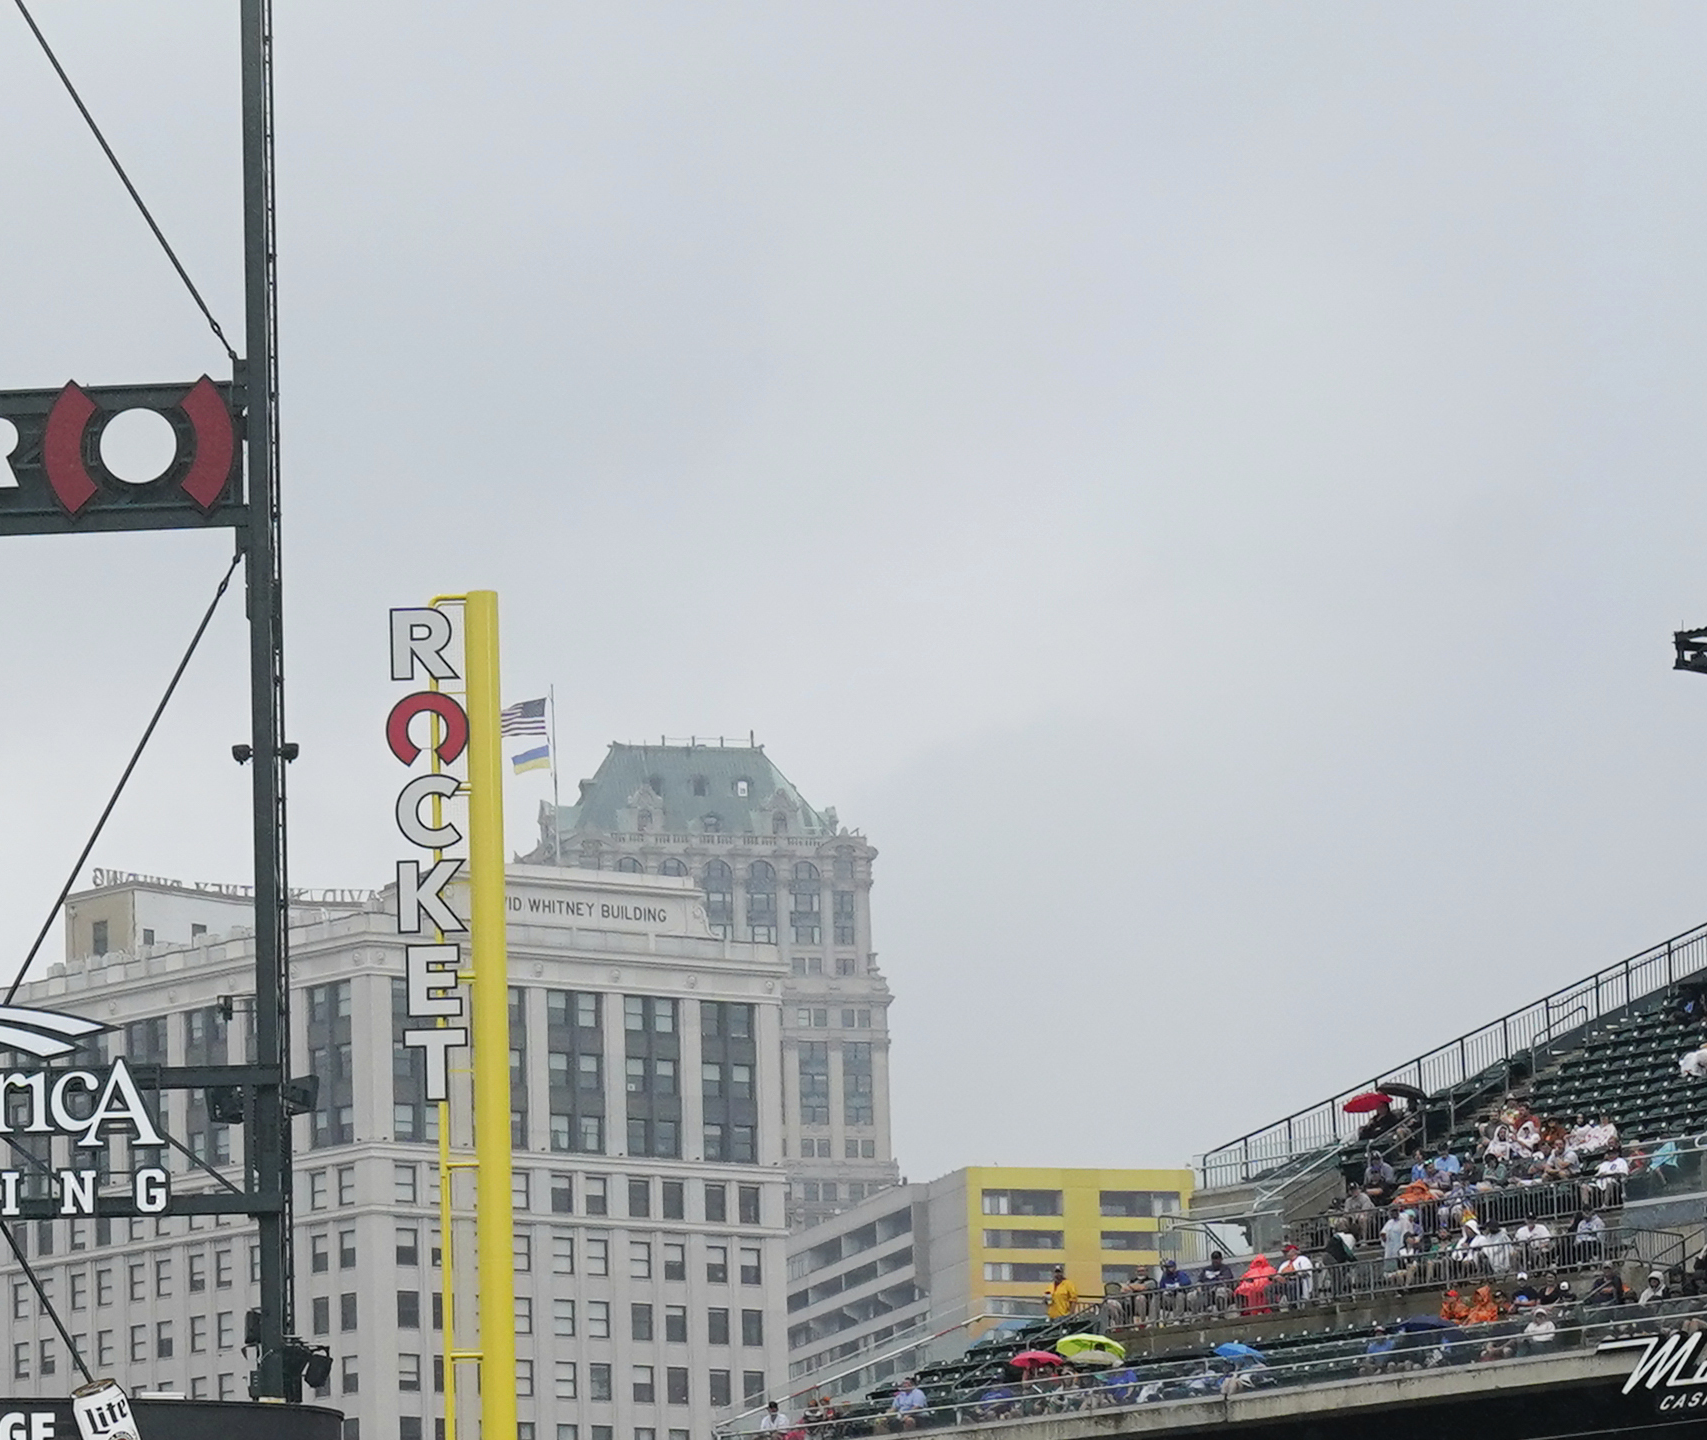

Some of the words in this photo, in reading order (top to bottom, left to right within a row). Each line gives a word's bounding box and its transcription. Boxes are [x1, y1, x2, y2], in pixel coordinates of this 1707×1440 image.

[386, 607, 469, 1101] ROCKET
[528, 897, 595, 917] WHITNEY
[601, 903, 667, 923] BUILDING
[84, 1398, 128, 1435] Lite
